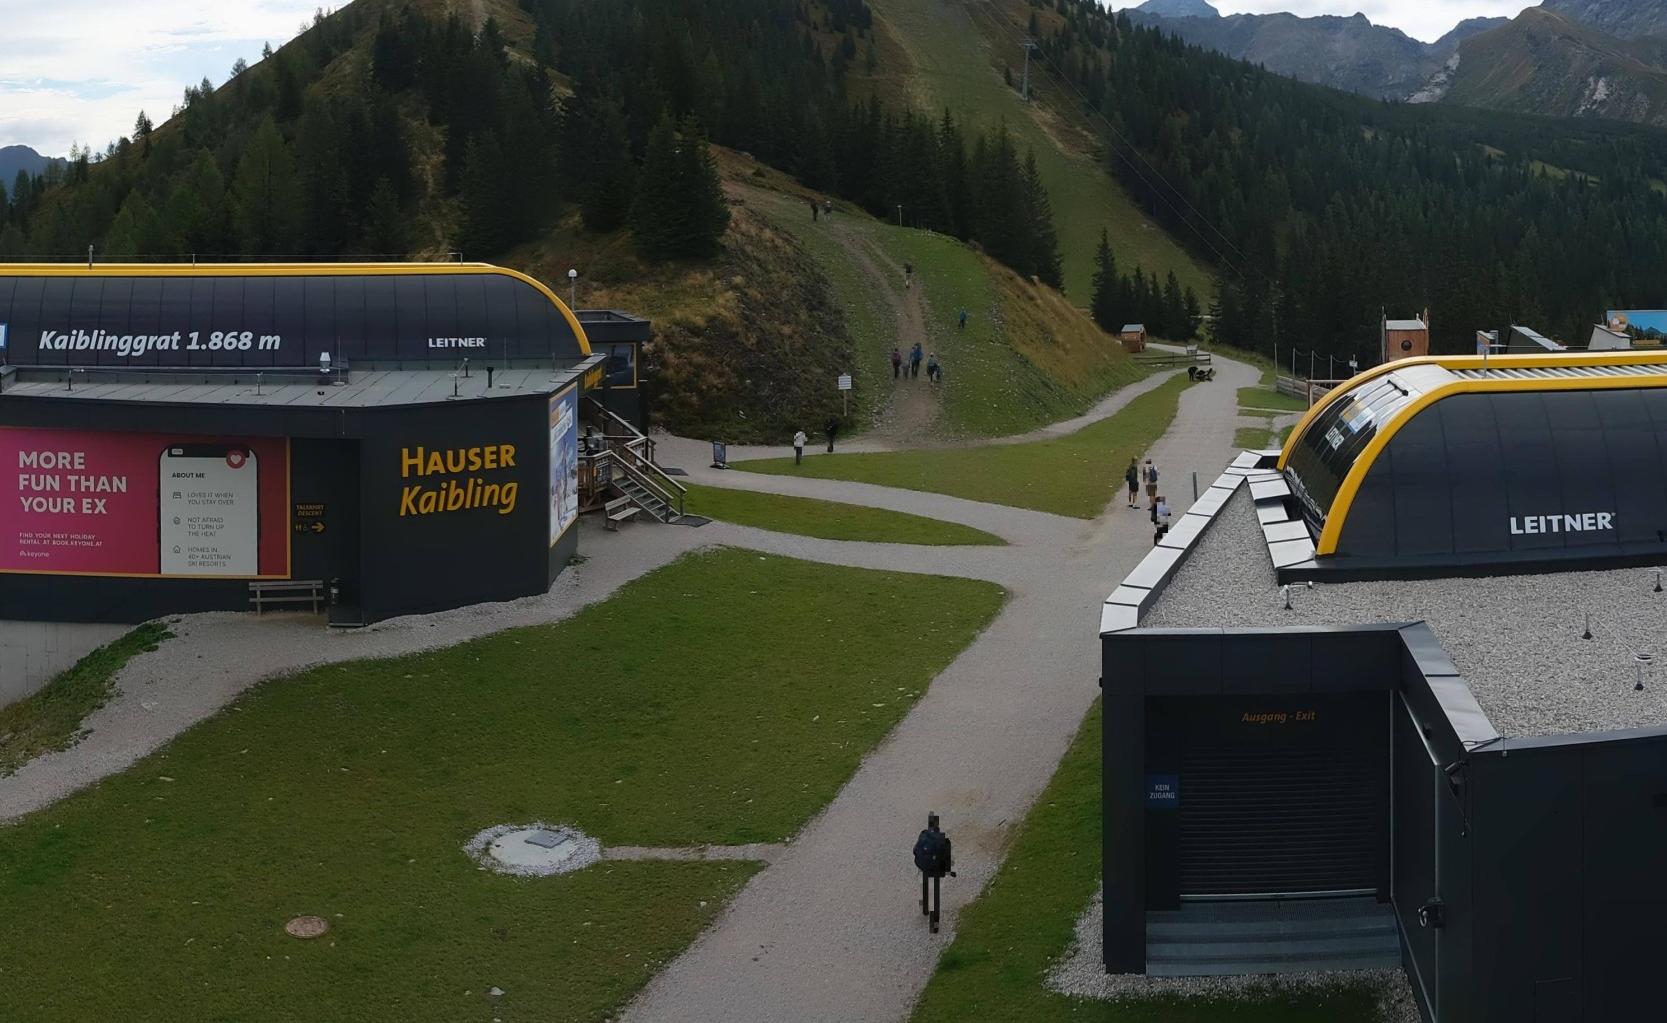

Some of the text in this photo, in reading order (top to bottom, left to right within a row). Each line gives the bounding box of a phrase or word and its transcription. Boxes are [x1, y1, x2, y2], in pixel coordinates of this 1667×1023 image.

[38, 329, 281, 357] Kaiblinggrat 1.868 m
[428, 337, 485, 348] LEITNER
[19, 450, 86, 470] MORE
[401, 444, 516, 478] HAUSER
[18, 473, 127, 493] FUN THAN
[20, 496, 108, 515] YOUR EX
[400, 478, 519, 517] Kaibling
[1510, 512, 1614, 535] LEITNER
[27, 550, 50, 558] keyone
[1241, 712, 1287, 724] Ausgang
[1295, 711, 1316, 721] Exit
[1149, 792, 1175, 800] ZUGANG
